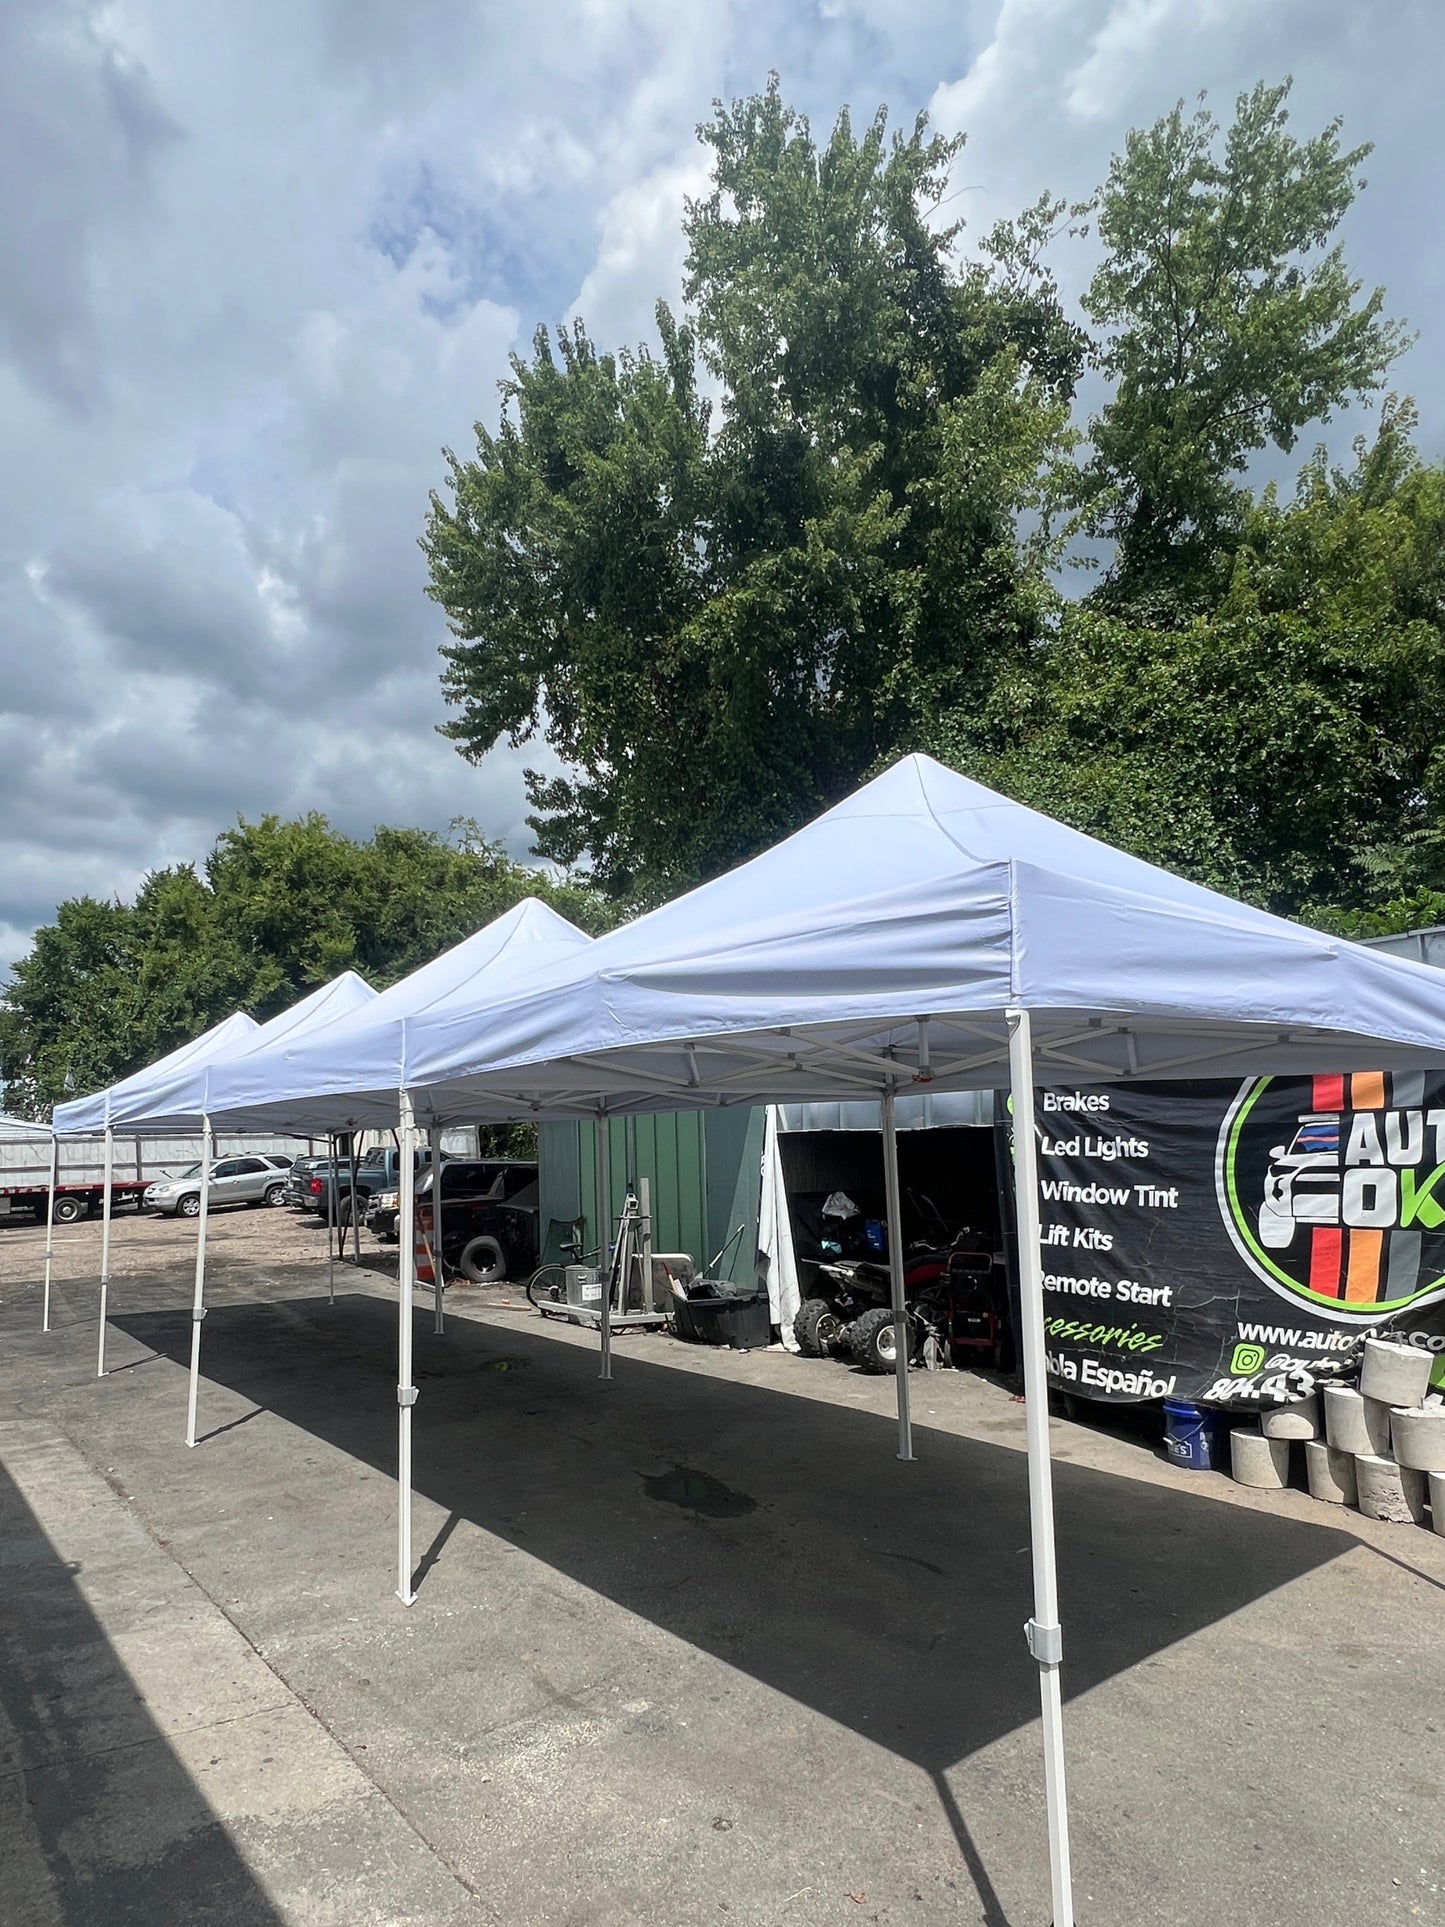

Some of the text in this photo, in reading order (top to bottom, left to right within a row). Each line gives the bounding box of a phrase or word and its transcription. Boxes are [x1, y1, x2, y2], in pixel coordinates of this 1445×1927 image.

[1043, 1091, 1110, 1112] Brakes
[1041, 1136, 1080, 1156] Led
[1084, 1136, 1149, 1161] Lights
[1041, 1180, 1179, 1208] Window Tint
[1039, 1224, 1114, 1251] Lift Kits
[1116, 1280, 1173, 1307] Start
[1081, 1359, 1177, 1397] Español
